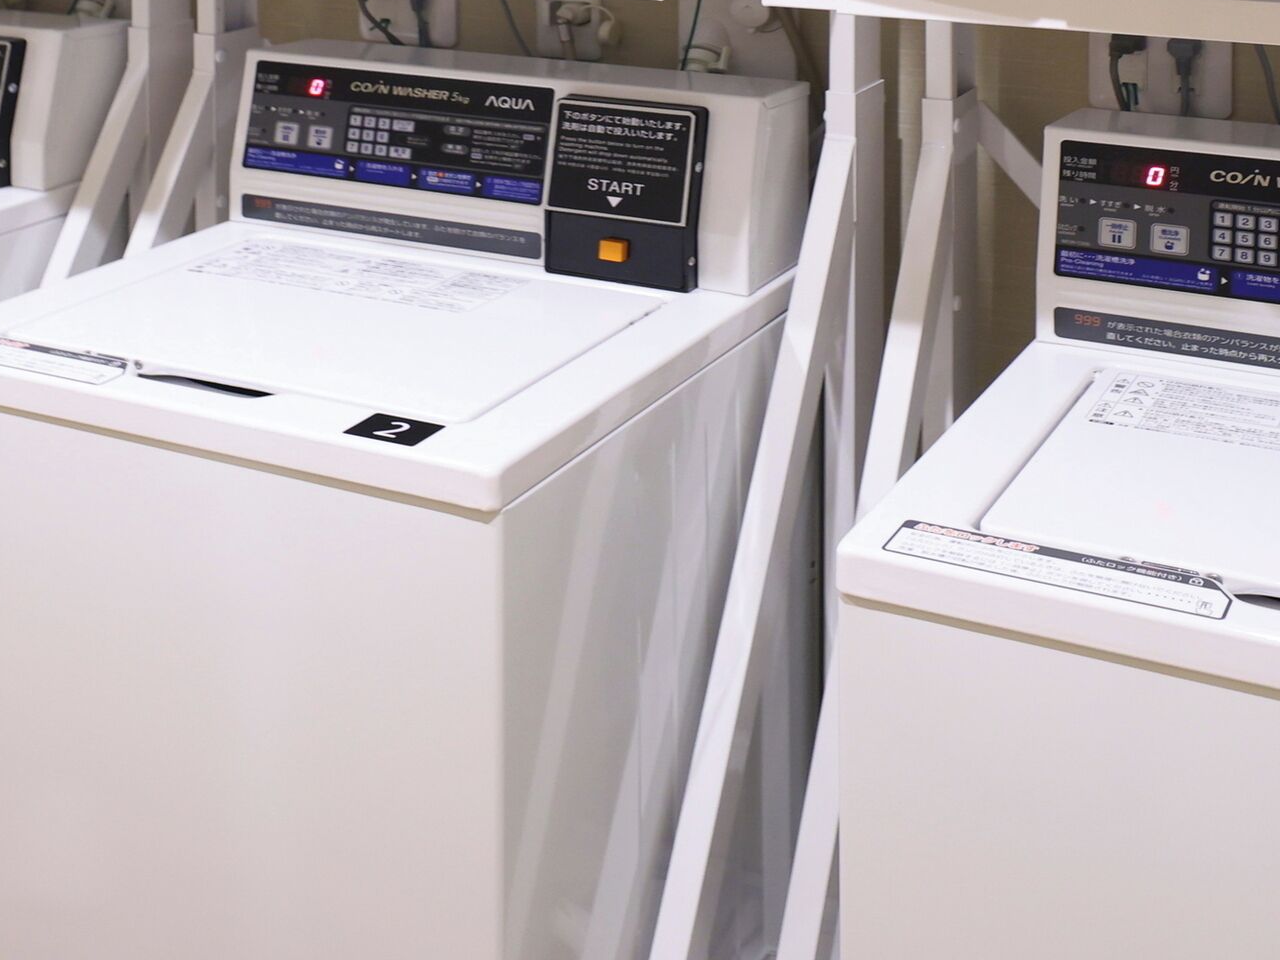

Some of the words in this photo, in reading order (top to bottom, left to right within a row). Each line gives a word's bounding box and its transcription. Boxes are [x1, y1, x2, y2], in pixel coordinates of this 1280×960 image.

[351, 80, 390, 95] COIN
[392, 85, 451, 101] WASHER
[485, 95, 535, 111] AQUA
[1063, 156, 1097, 165] 投入金額
[1062, 169, 1096, 179] 残り時間
[1146, 167, 1165, 186] 0
[1209, 169, 1271, 187] COIN
[587, 178, 644, 196] START
[1242, 218, 1249, 226] 2
[1264, 220, 1271, 228] 3
[1218, 232, 1225, 240] 4
[1264, 237, 1270, 245] 6
[1218, 249, 1225, 257] 7
[1240, 251, 1248, 260] 8
[1264, 254, 1270, 262] 9
[1074, 313, 1102, 327] 999
[372, 422, 410, 438] 2
